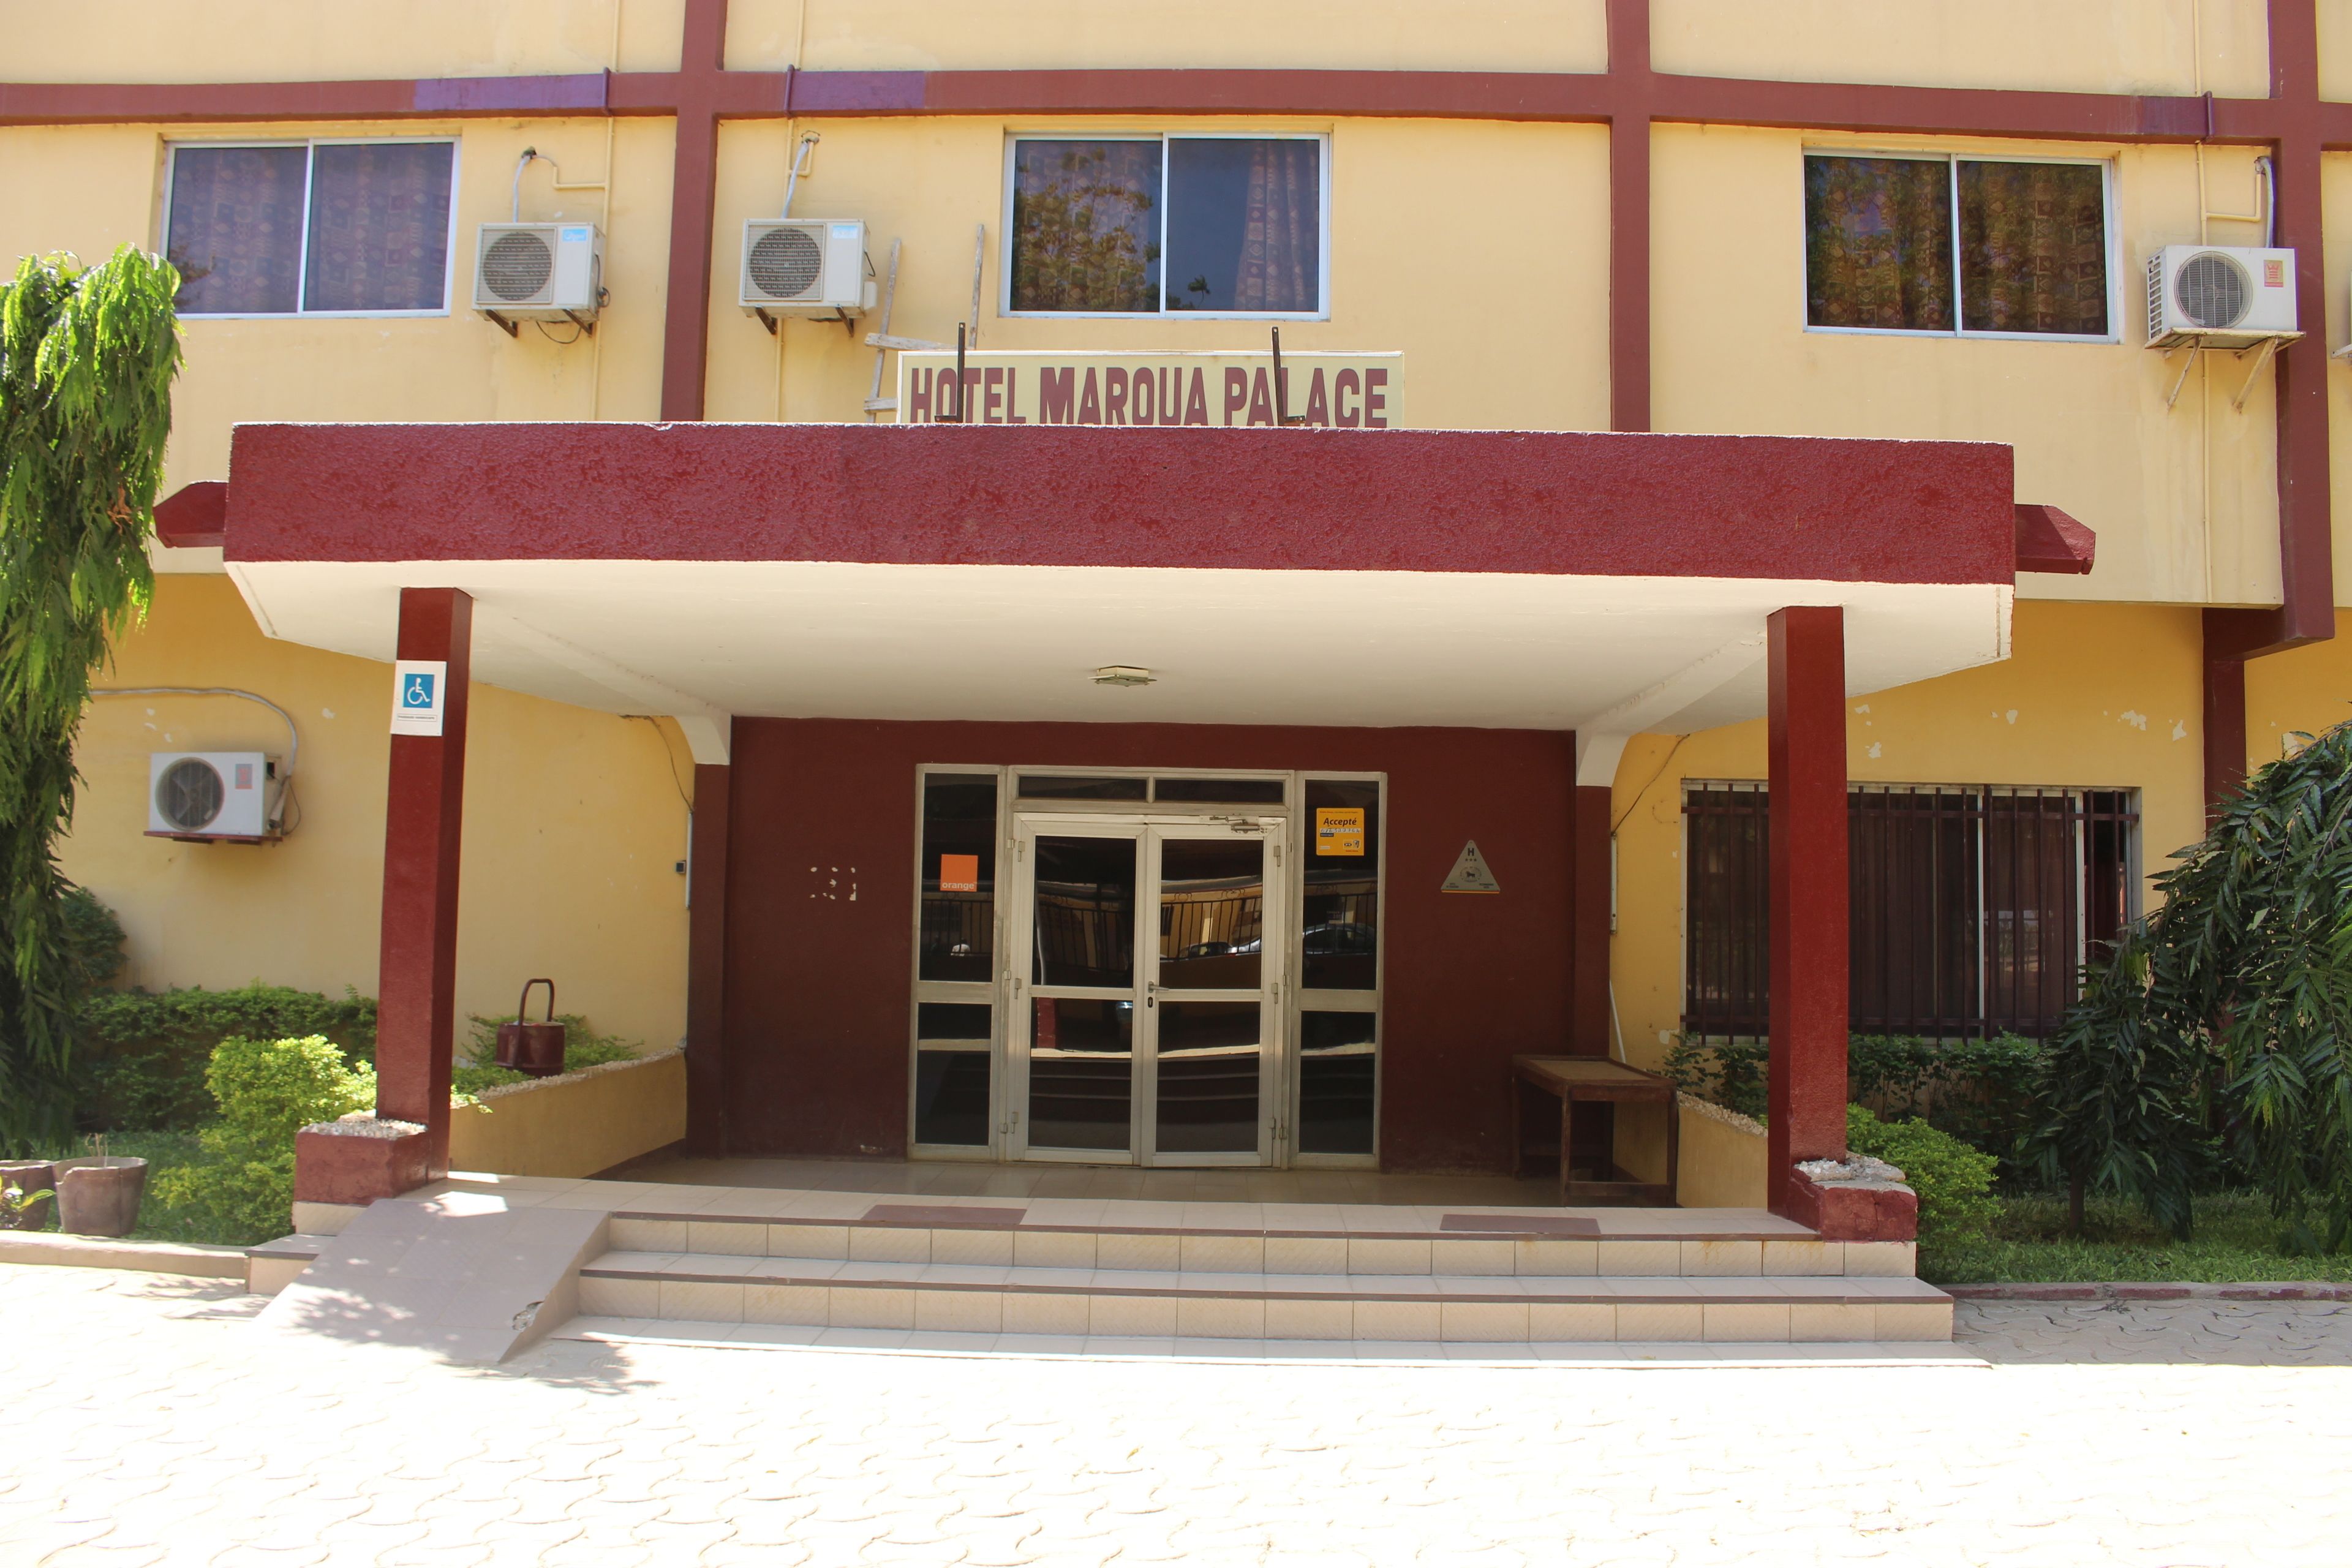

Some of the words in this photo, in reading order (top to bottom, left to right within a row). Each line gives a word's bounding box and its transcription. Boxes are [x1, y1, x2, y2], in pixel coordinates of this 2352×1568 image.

[910, 368, 1027, 423] HOTEL
[1039, 367, 1208, 426] MAROUA
[1224, 367, 1387, 428] PALACE
[1324, 817, 1357, 827] Accepté
[1468, 848, 1474, 856] H
